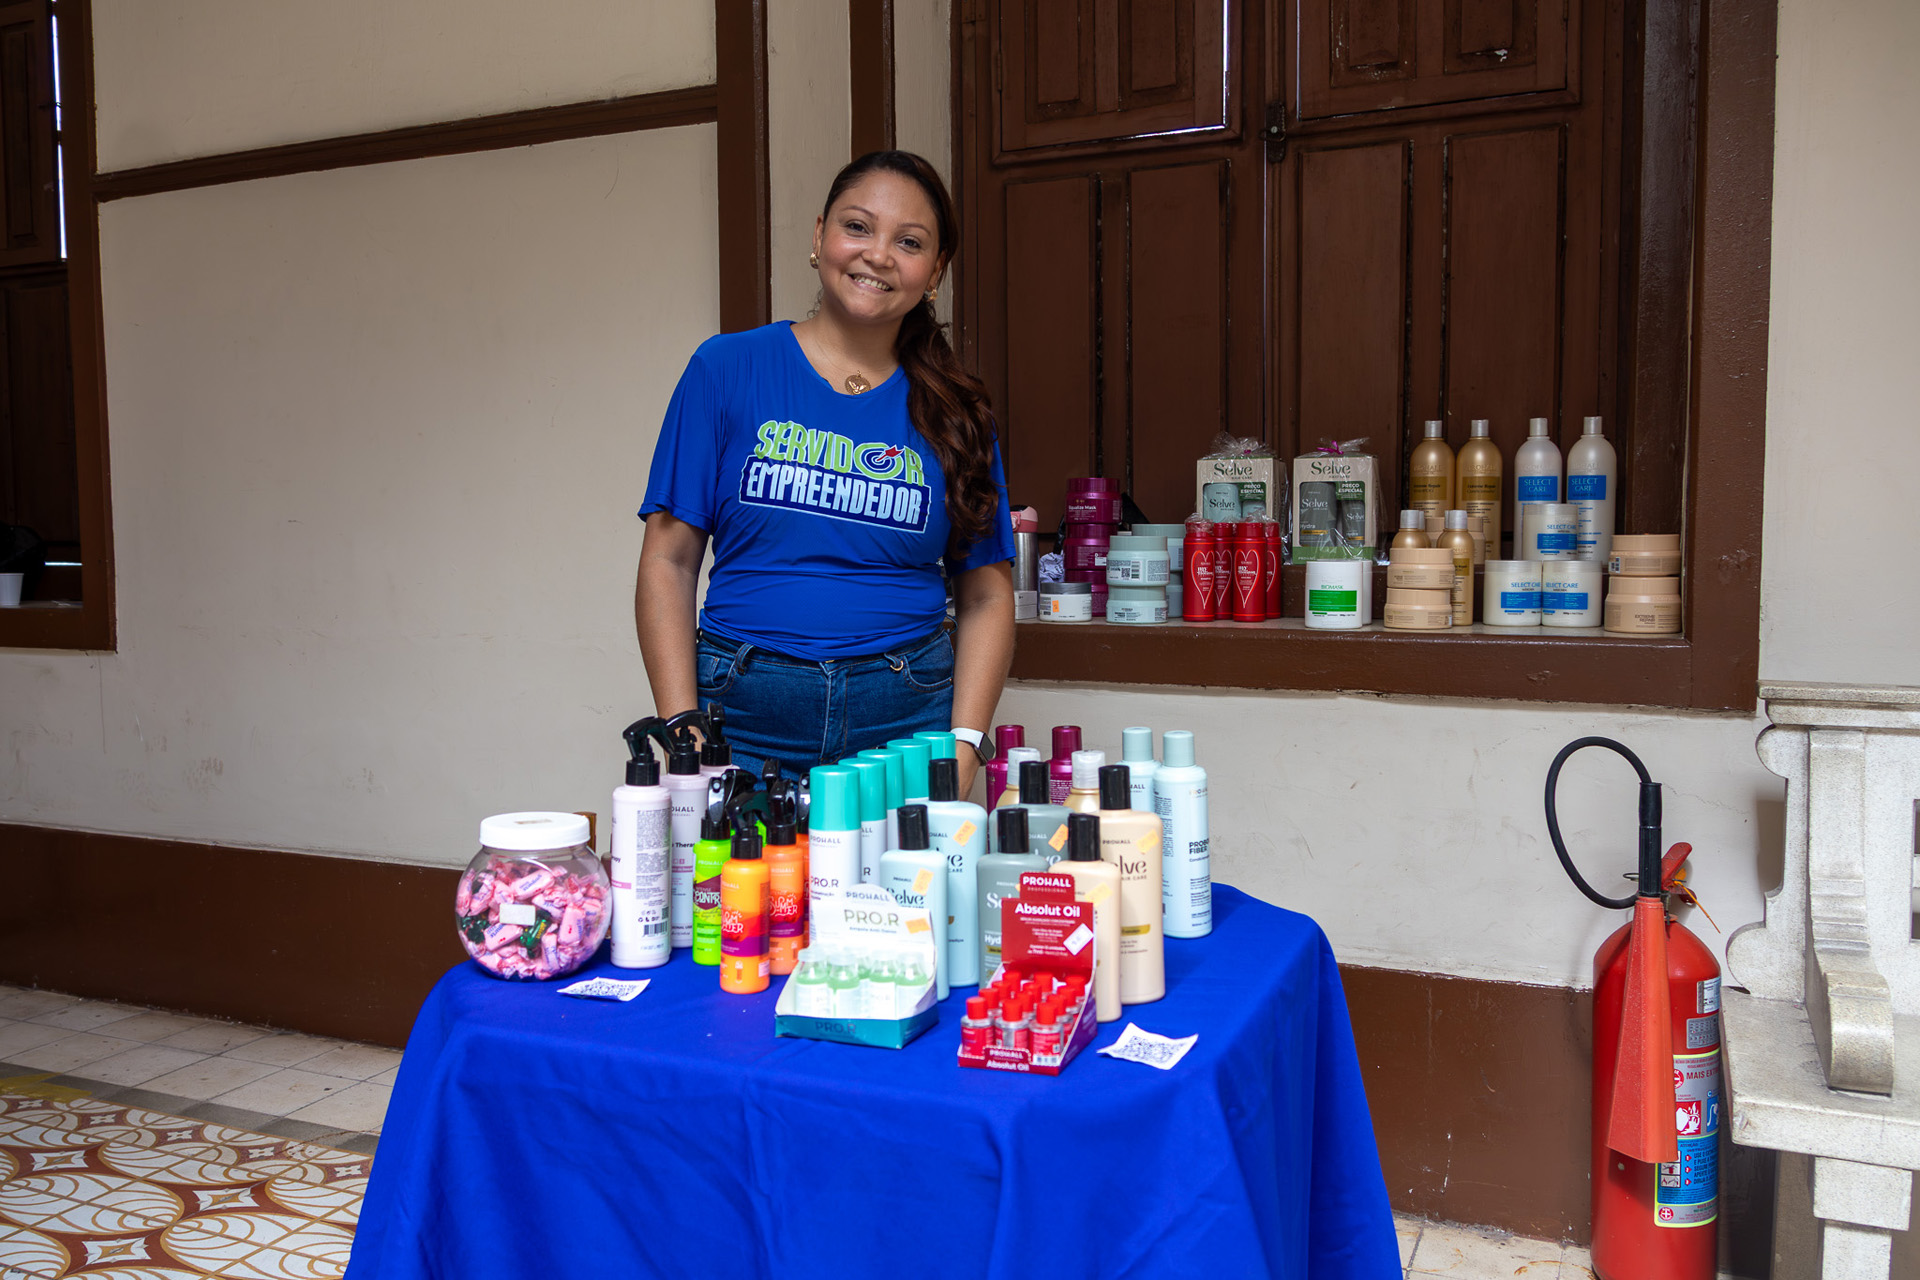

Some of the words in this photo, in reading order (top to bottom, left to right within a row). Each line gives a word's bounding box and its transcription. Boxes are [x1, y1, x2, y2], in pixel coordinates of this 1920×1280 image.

[754, 419, 925, 487] SERVIDOR
[1213, 462, 1253, 476] Selve
[1311, 460, 1351, 475] Selve
[1524, 478, 1552, 486] SELECT
[1571, 477, 1598, 485] SELECT
[746, 461, 923, 525] EMPREENDEDOR
[1209, 498, 1236, 508] Selve
[1302, 498, 1328, 508] Selve
[1188, 846, 1208, 855] FIBER
[811, 874, 839, 888] PRO.R
[1022, 875, 1072, 888] PROHALL
[845, 891, 890, 902] PROHALL
[1014, 902, 1062, 917] Absolut
[1062, 905, 1080, 918] Oil
[843, 908, 899, 927] PRO.R
[984, 934, 1002, 946] Hyd
[815, 1021, 857, 1034] PRO.R
[989, 1049, 1024, 1059] PROHALL
[986, 1060, 1017, 1071] Absolut
[1017, 1063, 1030, 1071] Oil
[1686, 1071, 1705, 1080] MAIS
